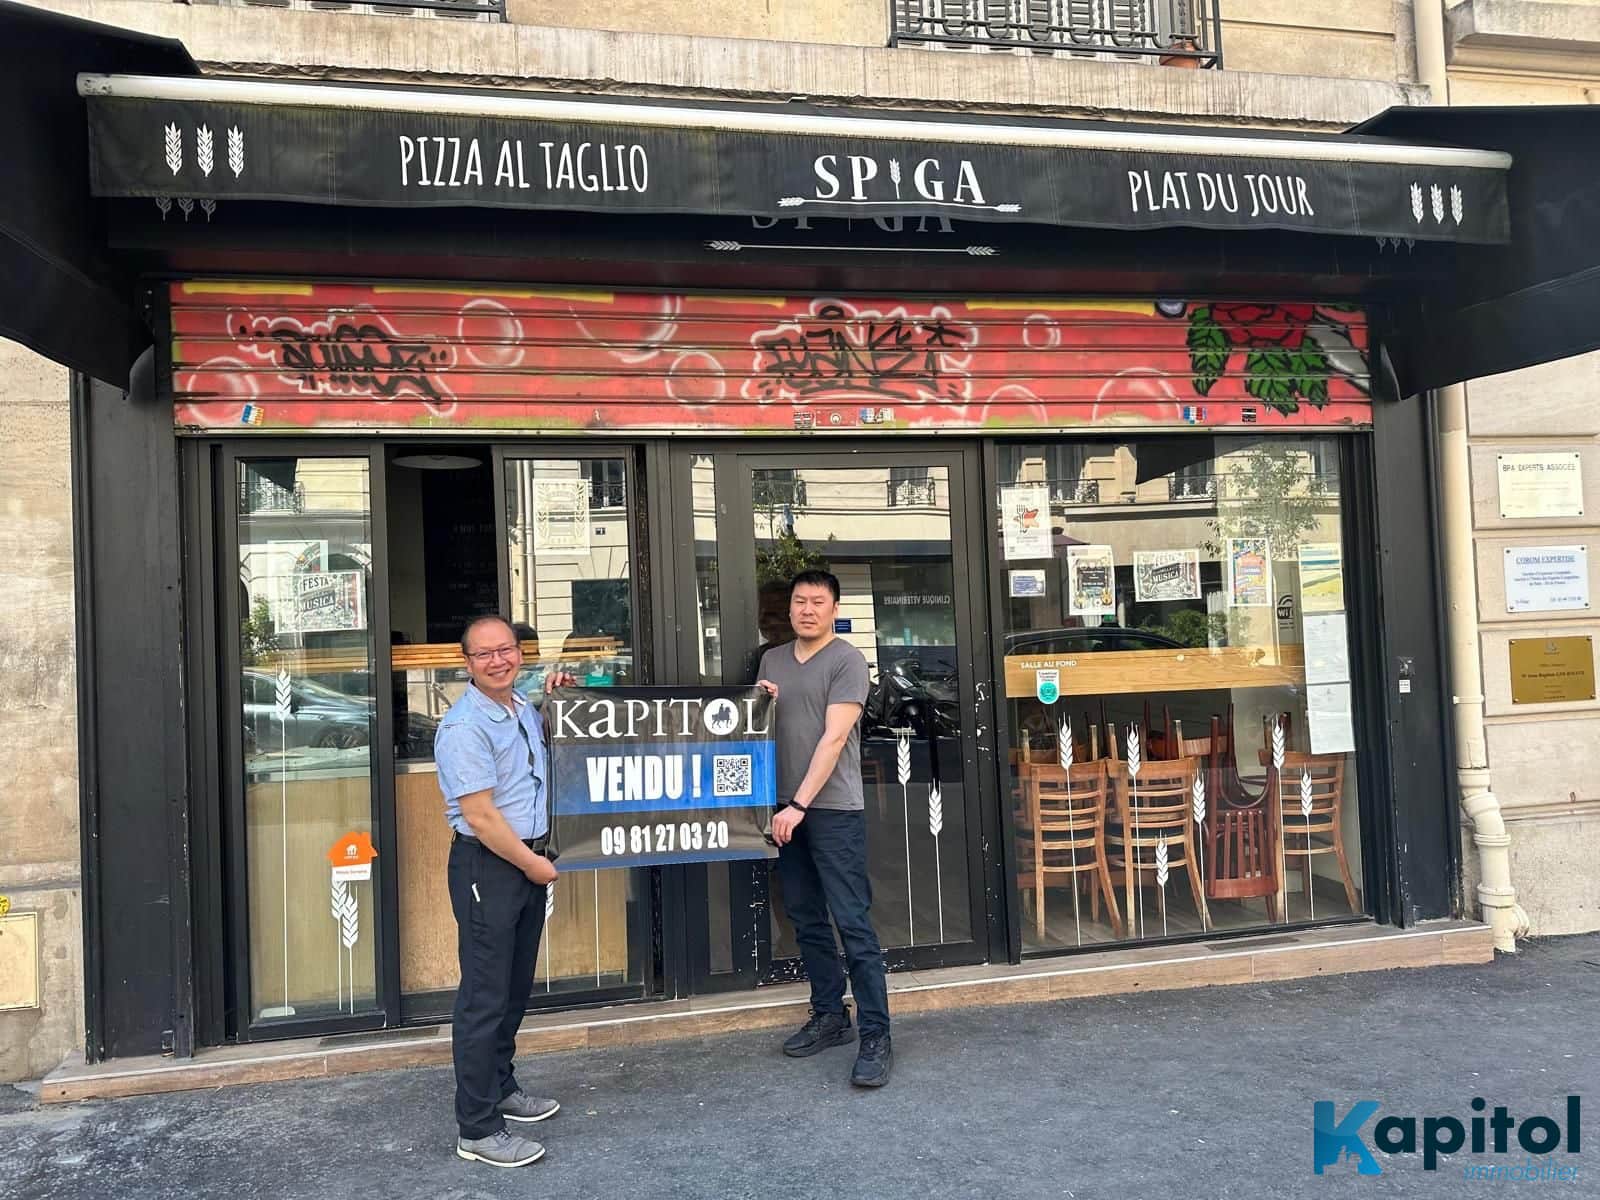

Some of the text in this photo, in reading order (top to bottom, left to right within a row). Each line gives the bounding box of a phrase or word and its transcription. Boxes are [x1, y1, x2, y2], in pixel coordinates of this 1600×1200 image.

[399, 135, 649, 193] PIZZA AL TAGLIO
[1127, 170, 1315, 217] PLAT DU JOUR
[303, 576, 330, 591] FESTA
[1152, 570, 1179, 583] MUSICA
[1021, 660, 1077, 669] SALLE AU FOND
[586, 754, 702, 803] VENDU !
[601, 820, 730, 857] 09 81 27 03 20
